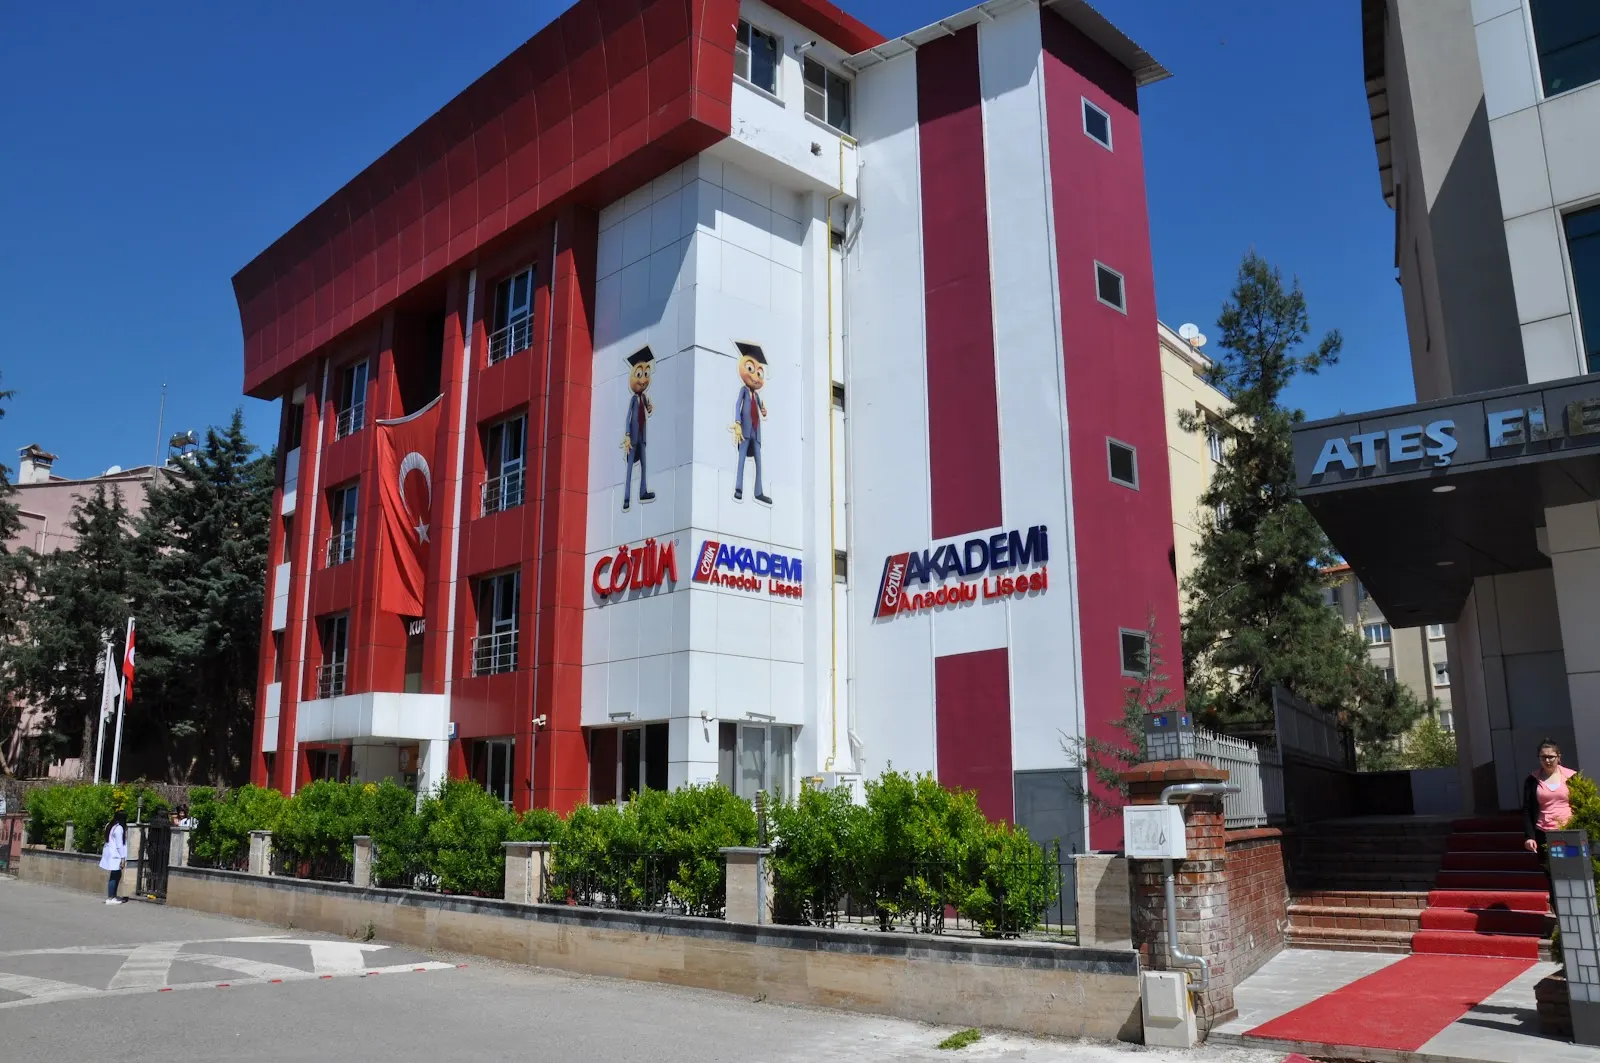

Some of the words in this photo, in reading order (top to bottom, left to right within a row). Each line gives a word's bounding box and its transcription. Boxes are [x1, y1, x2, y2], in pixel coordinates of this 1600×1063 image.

[1311, 419, 1458, 475] ATEŞ
[592, 537, 678, 597] ÇÖZÜM
[710, 569, 761, 592] Anadolu
[768, 578, 802, 600] Lisesi
[899, 580, 977, 613] Anadolu
[983, 566, 1048, 598] Lisesi
